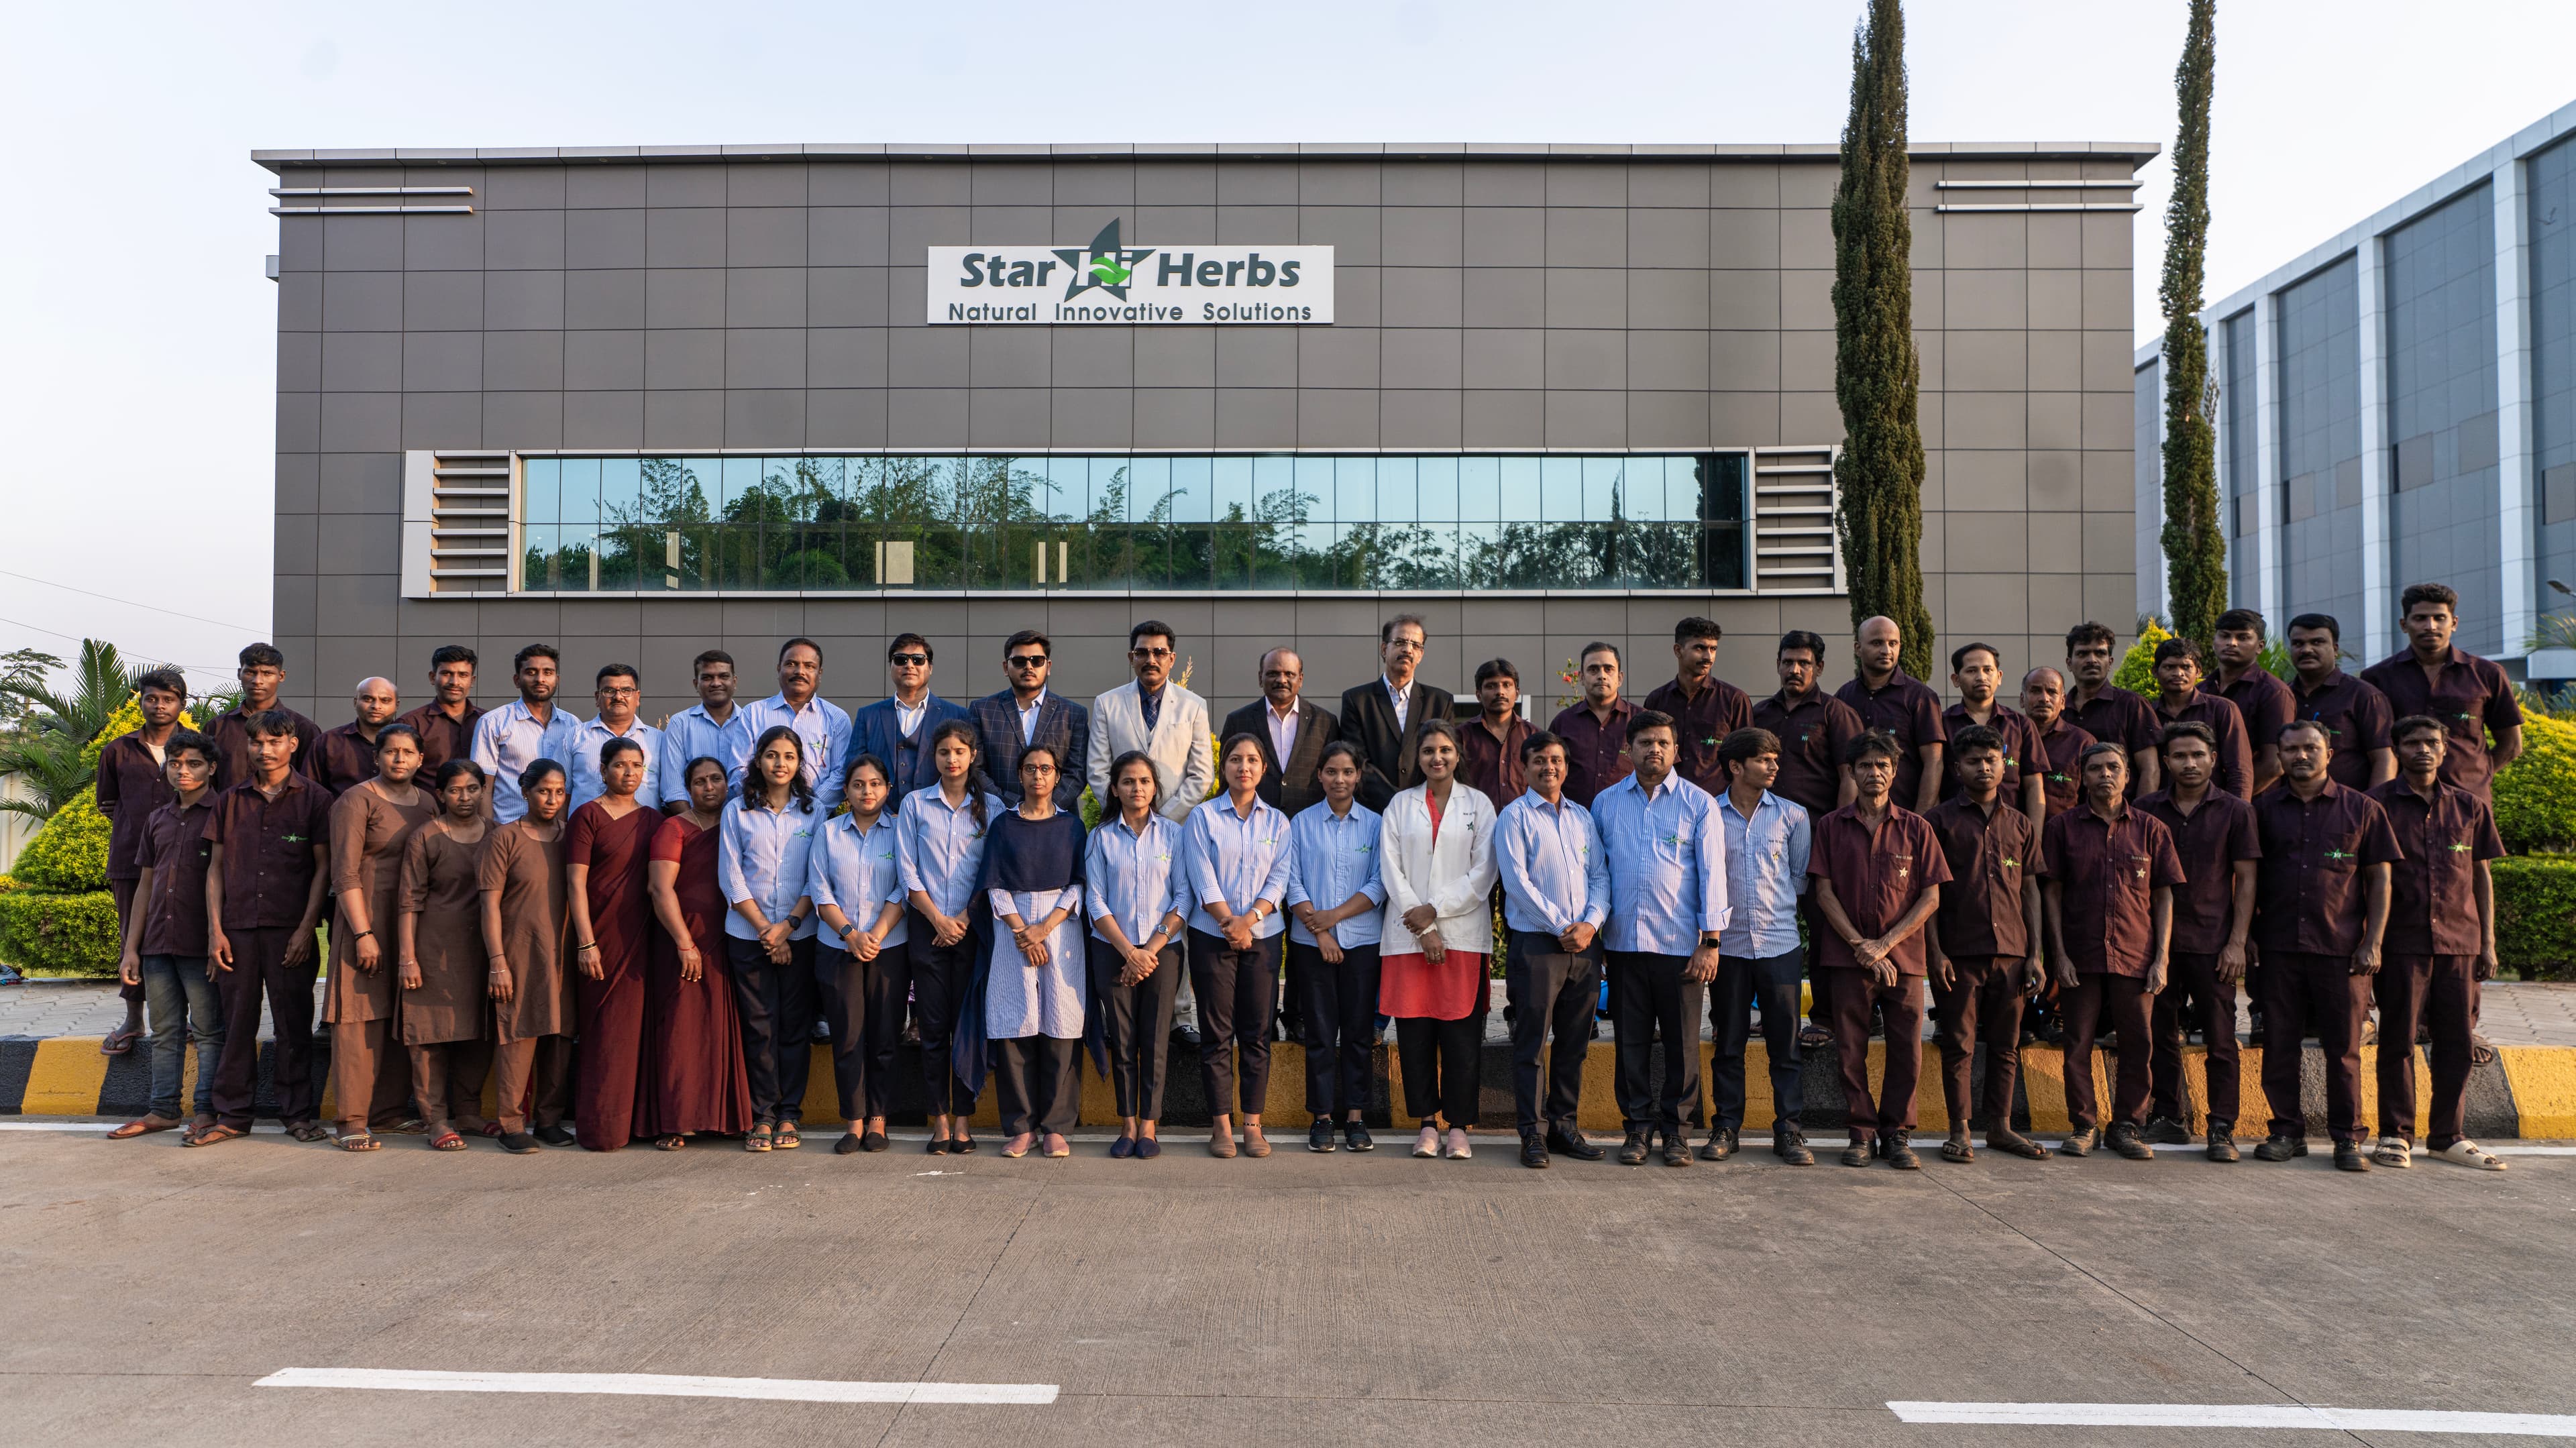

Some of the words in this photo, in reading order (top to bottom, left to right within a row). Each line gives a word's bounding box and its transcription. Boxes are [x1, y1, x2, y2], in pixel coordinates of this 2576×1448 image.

[961, 253, 1056, 287] Star
[1157, 253, 1300, 287] Herbs
[949, 303, 1036, 321] Natural
[1056, 302, 1183, 321] Innovative
[1203, 302, 1311, 321] Solutions
